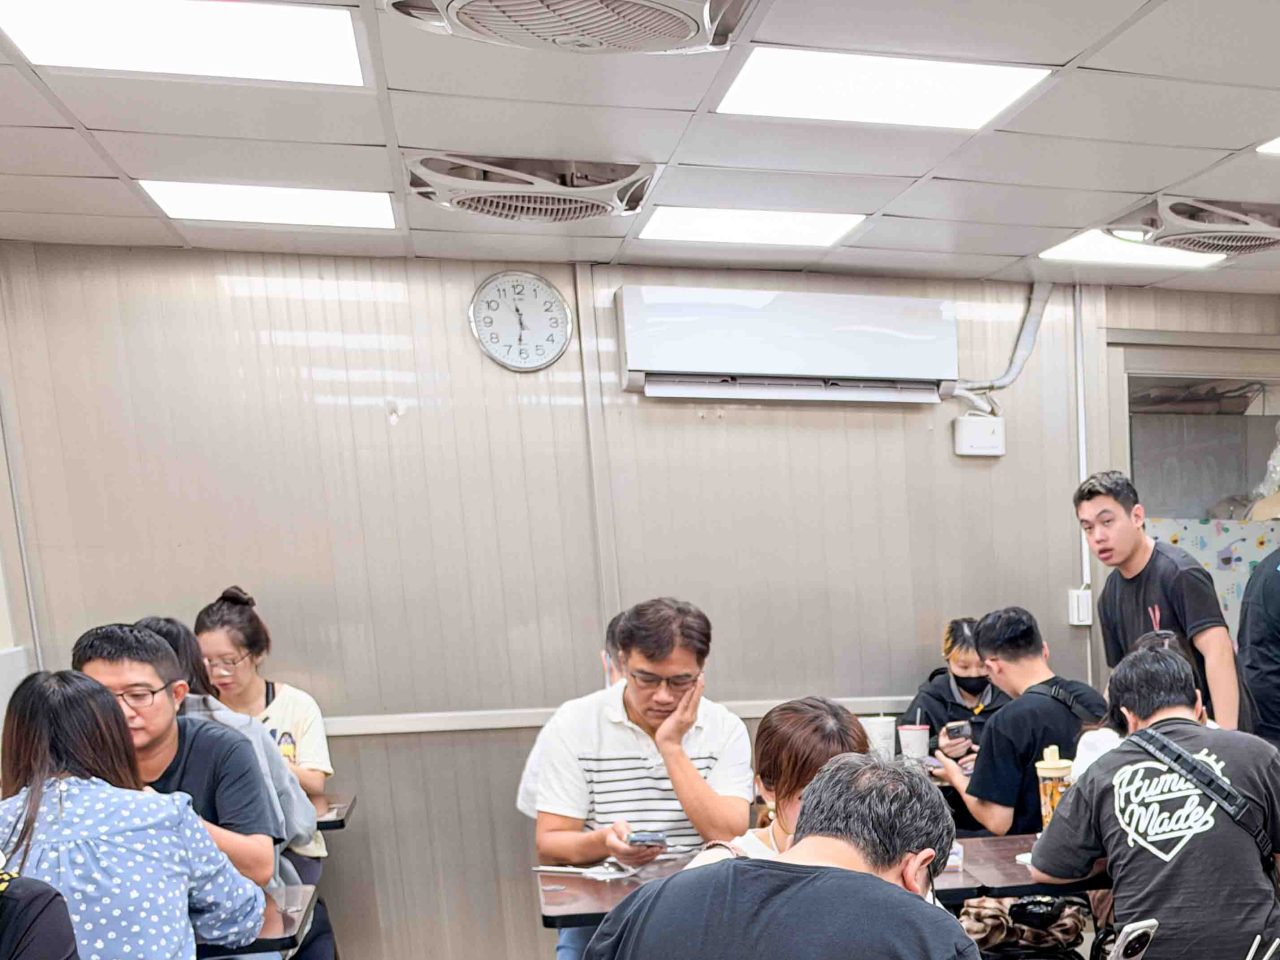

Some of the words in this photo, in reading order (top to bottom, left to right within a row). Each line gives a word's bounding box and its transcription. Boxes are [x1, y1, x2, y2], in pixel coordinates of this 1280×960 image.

[497, 288, 507, 299] 11
[512, 284, 525, 296] 12
[486, 300, 500, 311] 10
[543, 301, 553, 312] 2
[482, 316, 493, 328] 9
[549, 317, 559, 329] 3
[490, 332, 500, 344] 8
[545, 333, 555, 344] 4
[503, 344, 512, 356] 7
[519, 347, 530, 360] 6
[535, 345, 545, 357] 5
[1113, 763, 1199, 808] Hum
